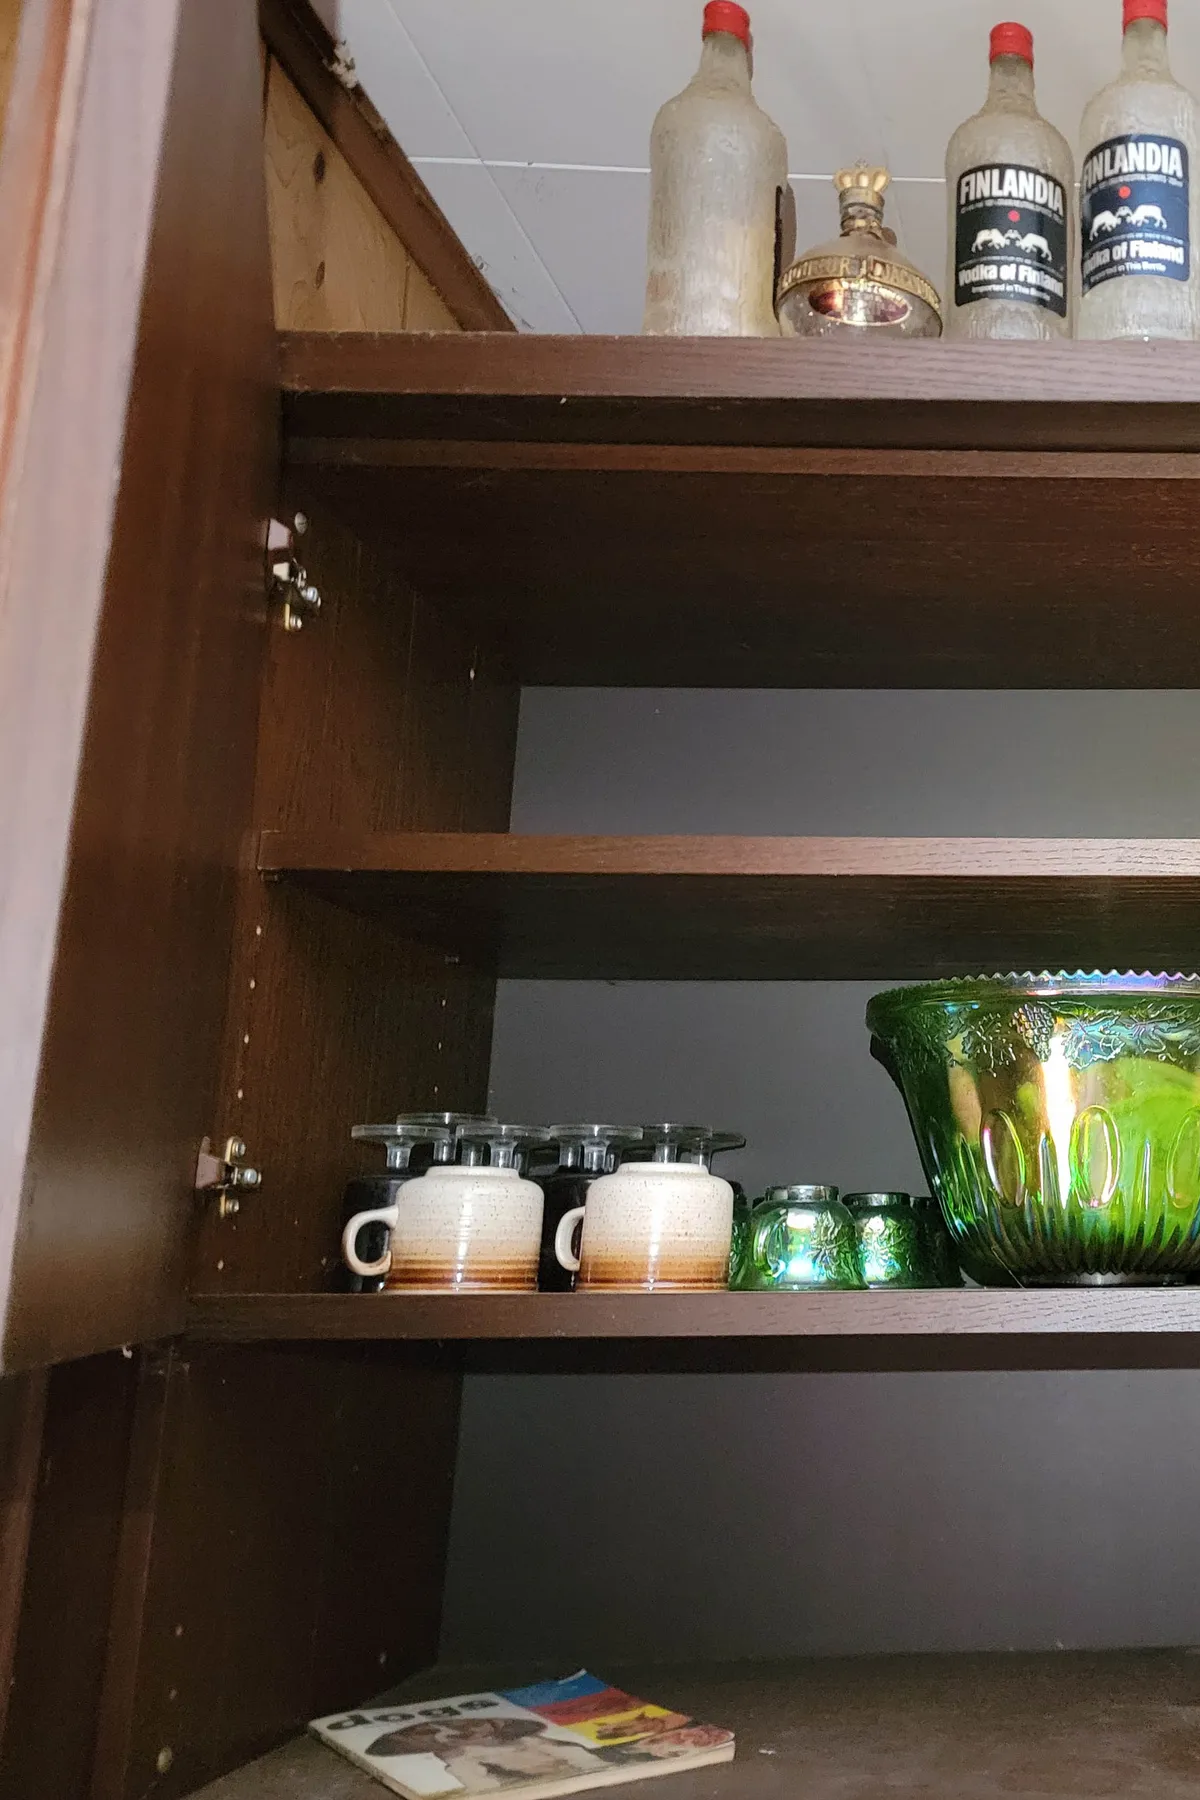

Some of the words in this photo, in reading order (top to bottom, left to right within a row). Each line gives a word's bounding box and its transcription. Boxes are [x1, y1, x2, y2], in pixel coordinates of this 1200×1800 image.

[1083, 142, 1184, 194] FINLANDIA
[960, 168, 1064, 216] FINLANDIA
[1112, 241, 1128, 261] of
[1129, 240, 1185, 265] Finland
[958, 263, 998, 287] Vodka
[1000, 263, 1017, 281] of
